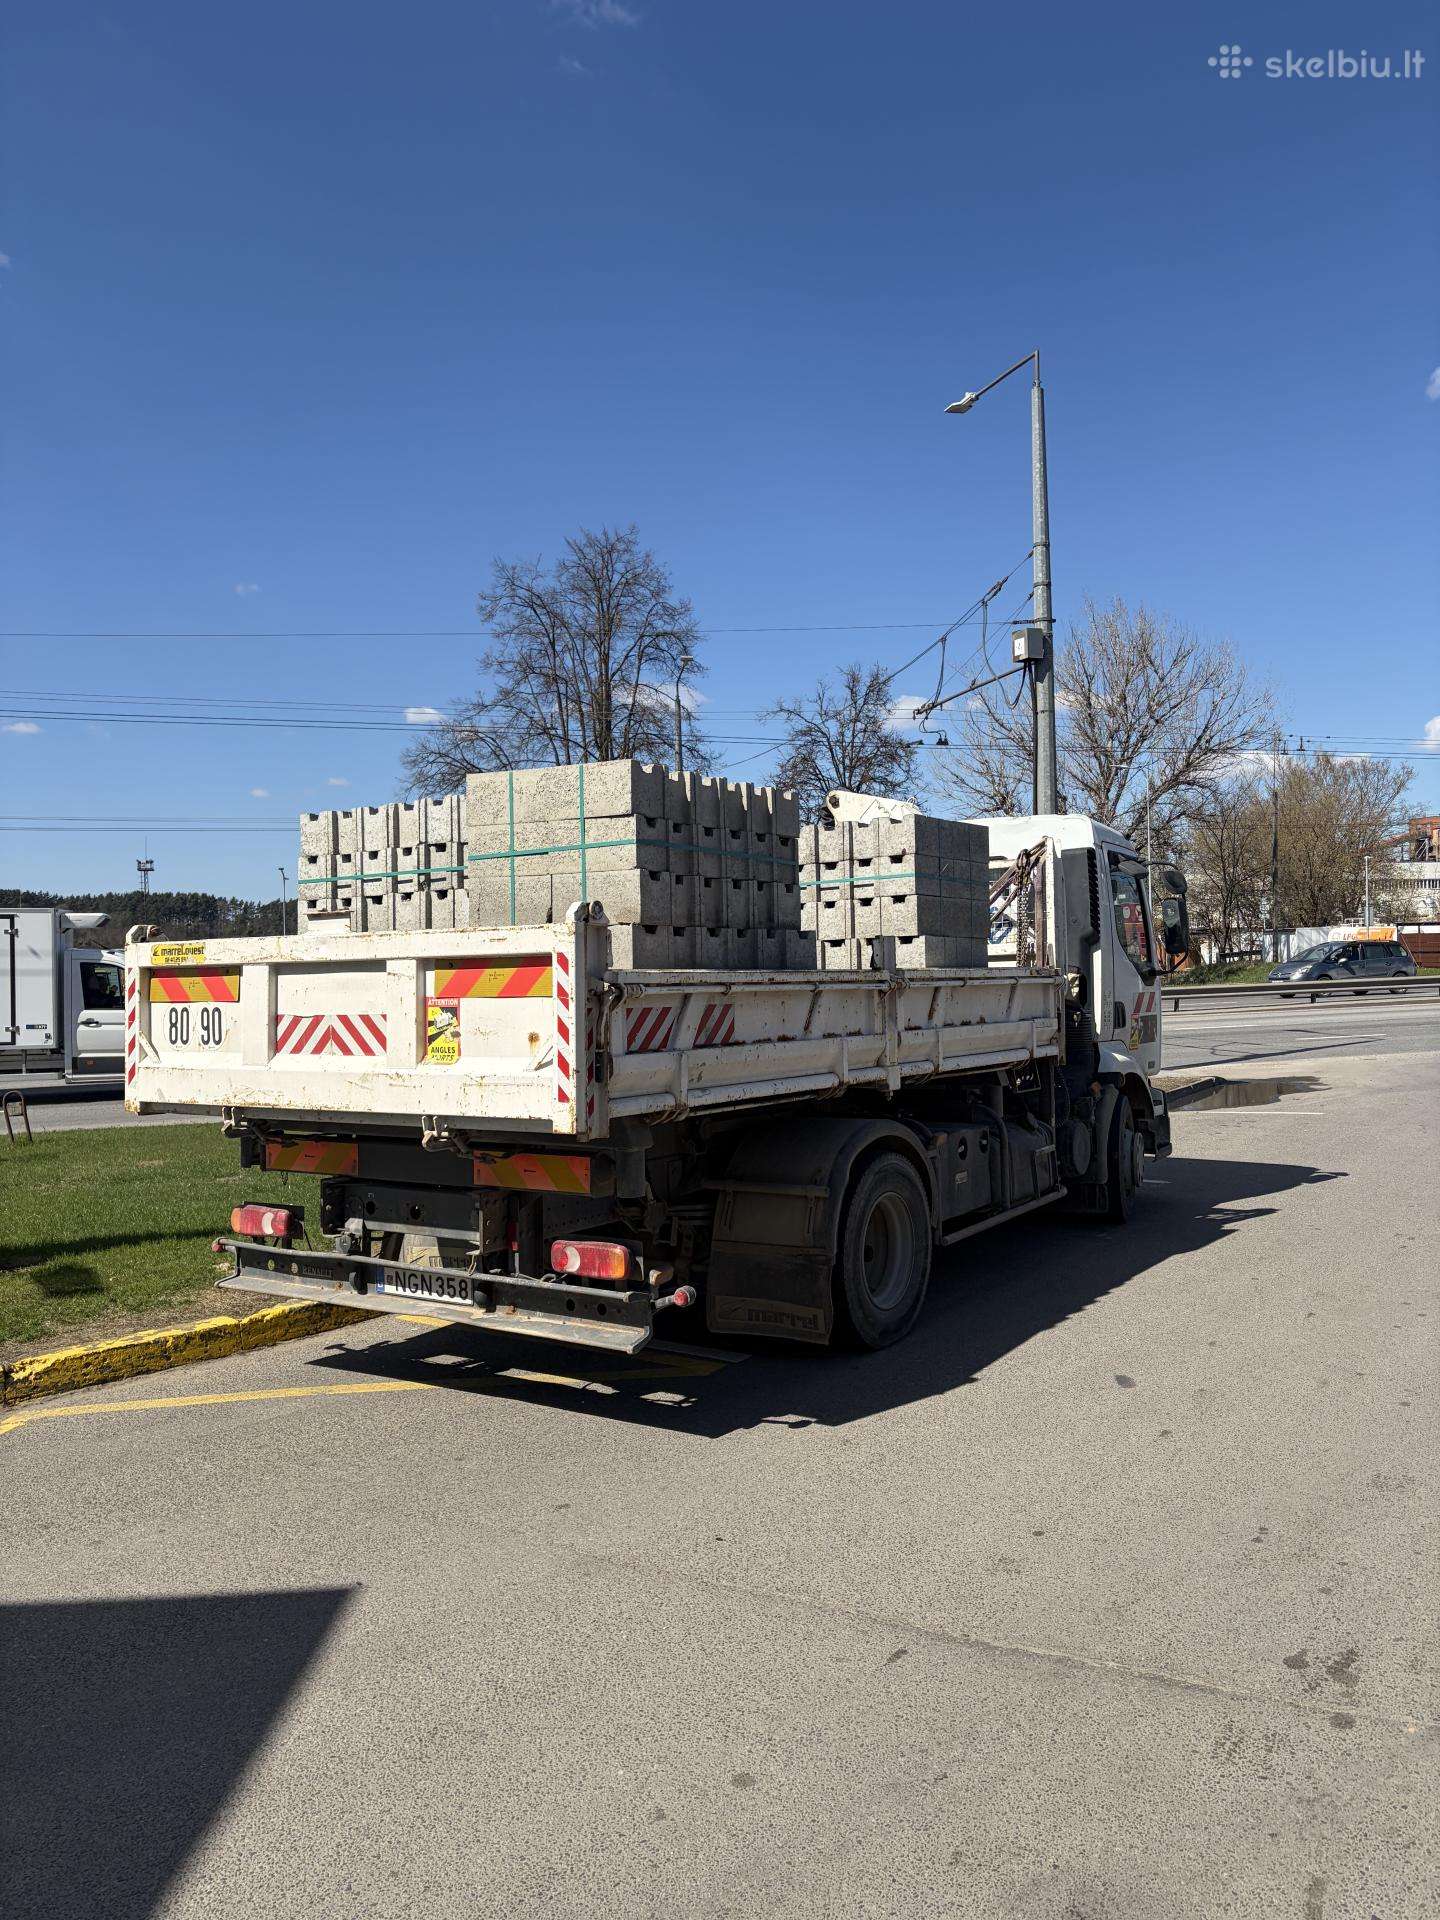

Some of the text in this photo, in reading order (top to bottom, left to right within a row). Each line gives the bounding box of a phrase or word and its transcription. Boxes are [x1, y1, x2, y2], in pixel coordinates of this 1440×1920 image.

[168, 1006, 190, 1046] 80
[200, 1006, 223, 1046] 90
[430, 1046, 456, 1054] ANGLES
[395, 1270, 469, 1301] NGN358
